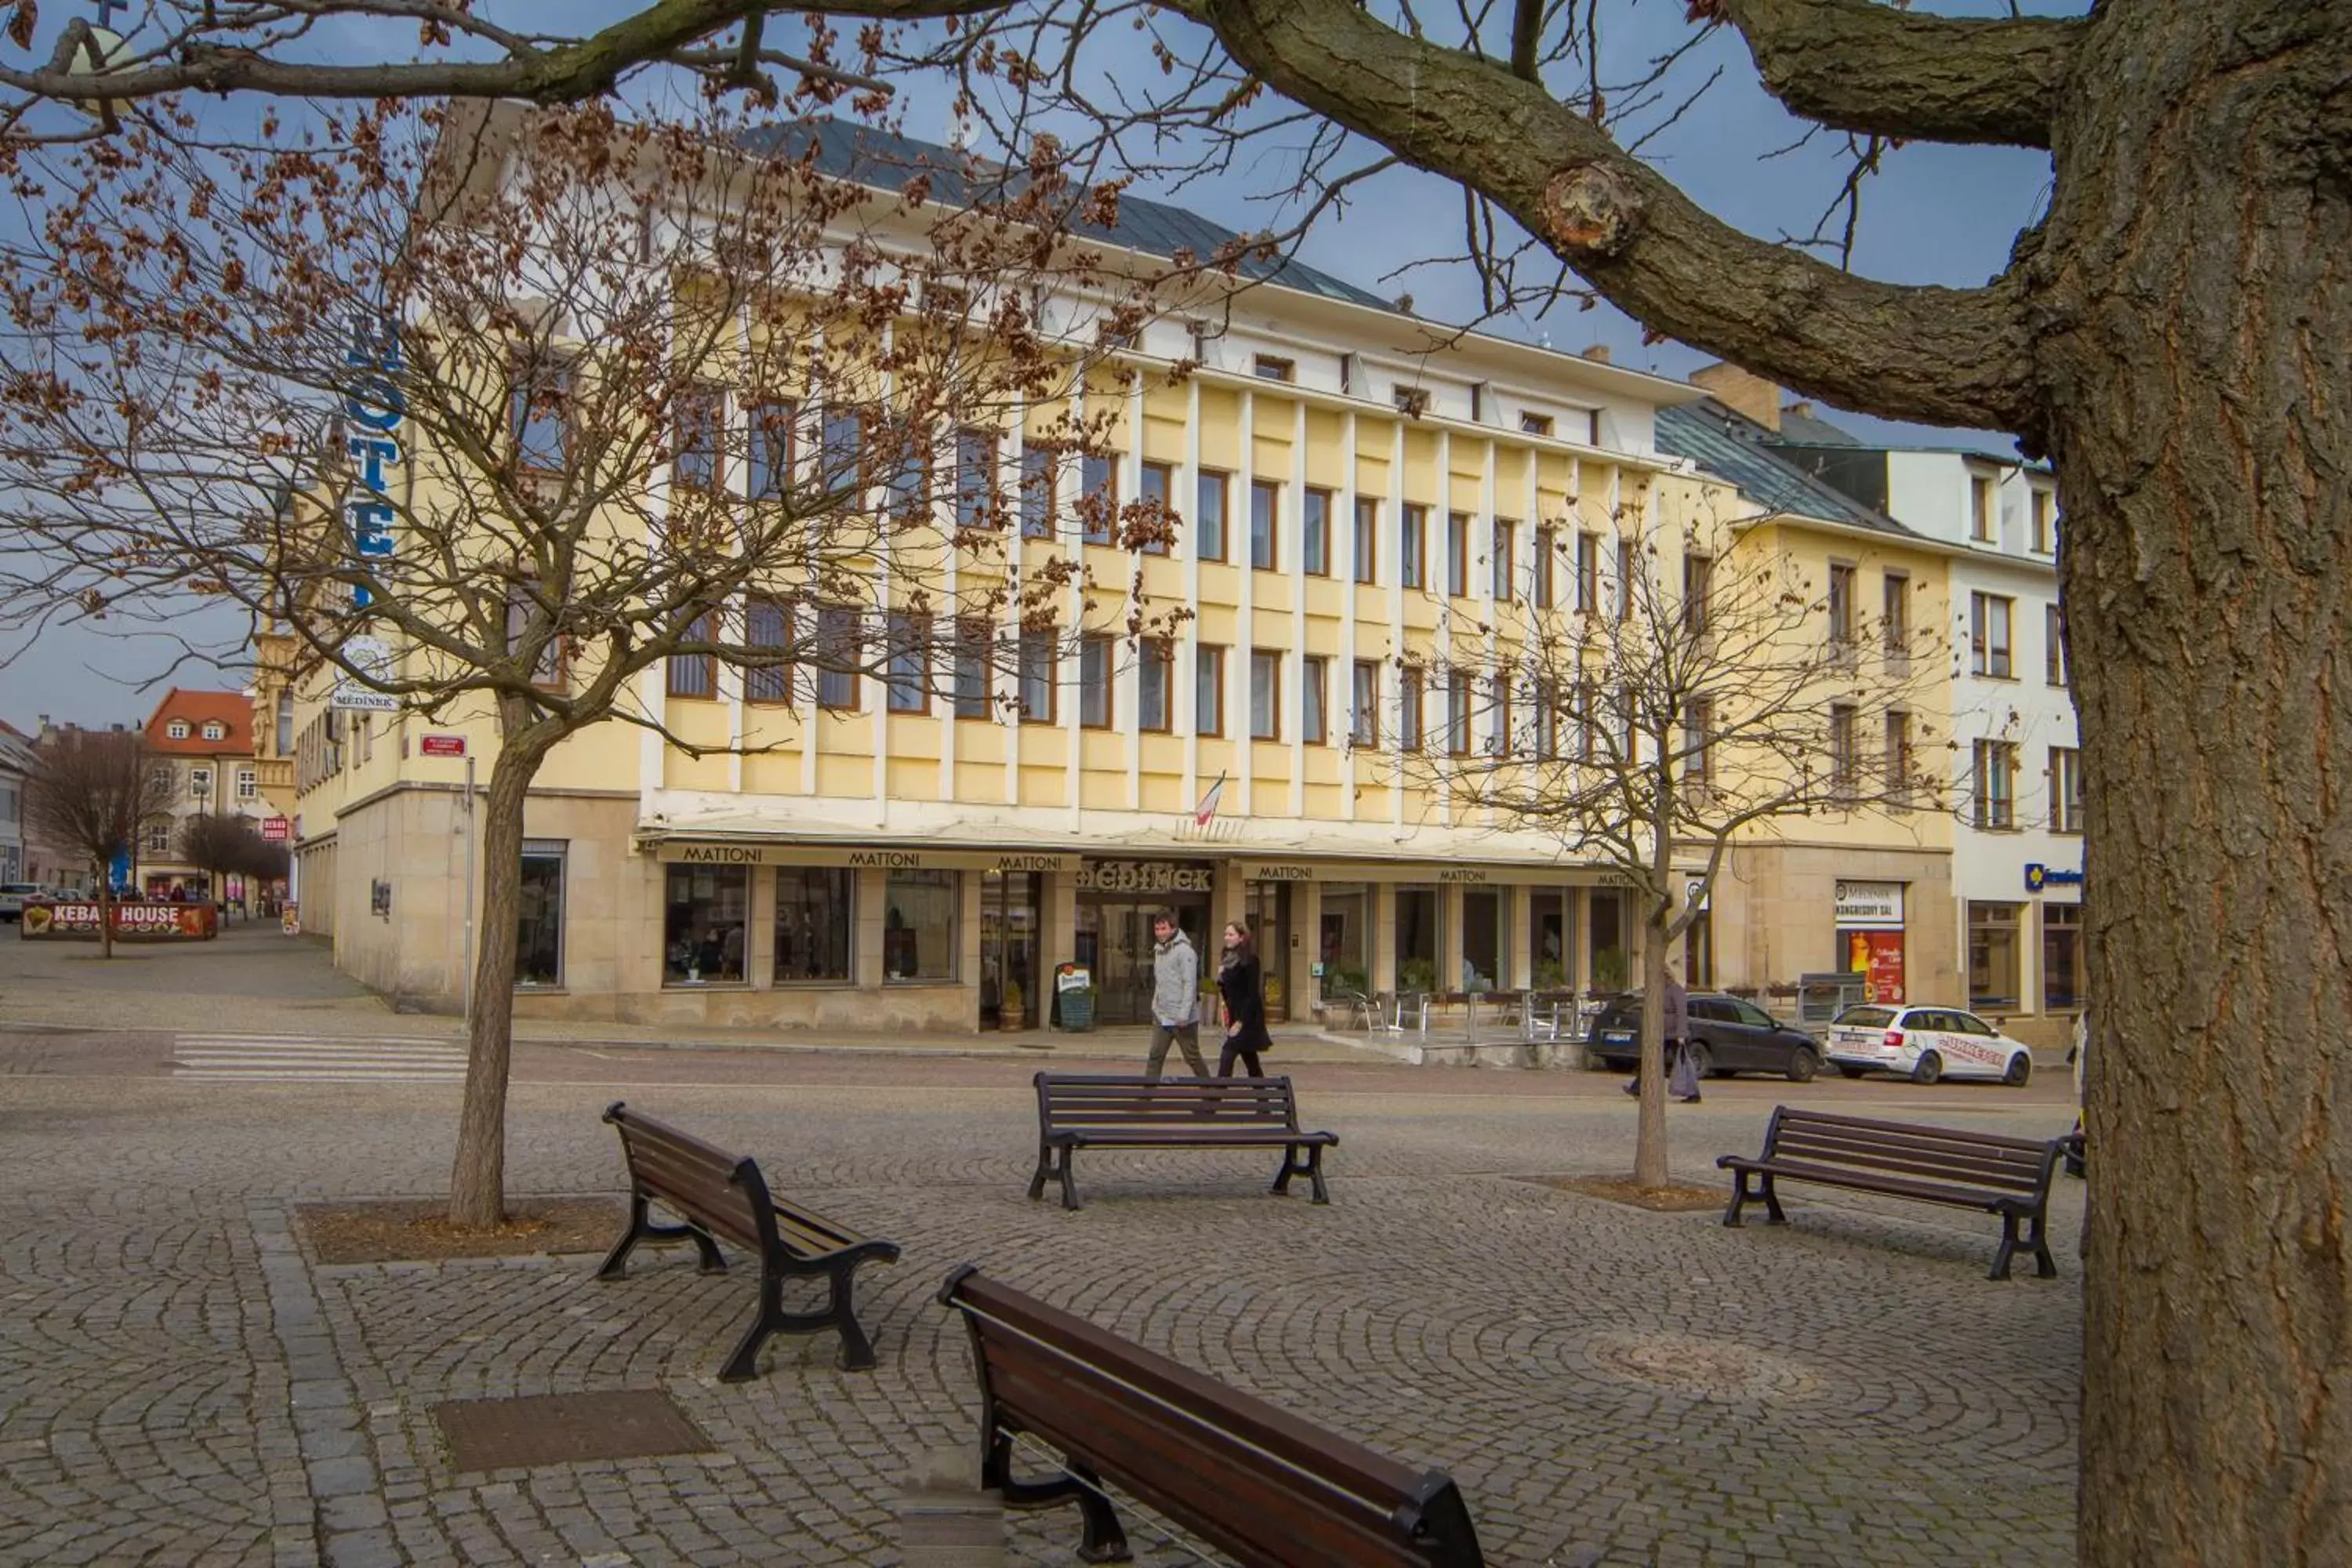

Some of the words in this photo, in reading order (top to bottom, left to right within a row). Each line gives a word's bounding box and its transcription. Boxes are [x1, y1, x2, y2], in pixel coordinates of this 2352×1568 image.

[347, 316, 405, 609] HOTE
[684, 847, 762, 862] MATTONI
[848, 852, 920, 866] MATTONI
[998, 856, 1062, 870] MATTONI
[1258, 866, 1312, 879] MATTONI
[1440, 869, 1486, 882] MATTONI
[54, 906, 112, 922] KEBA
[122, 907, 180, 923] HOUSE
